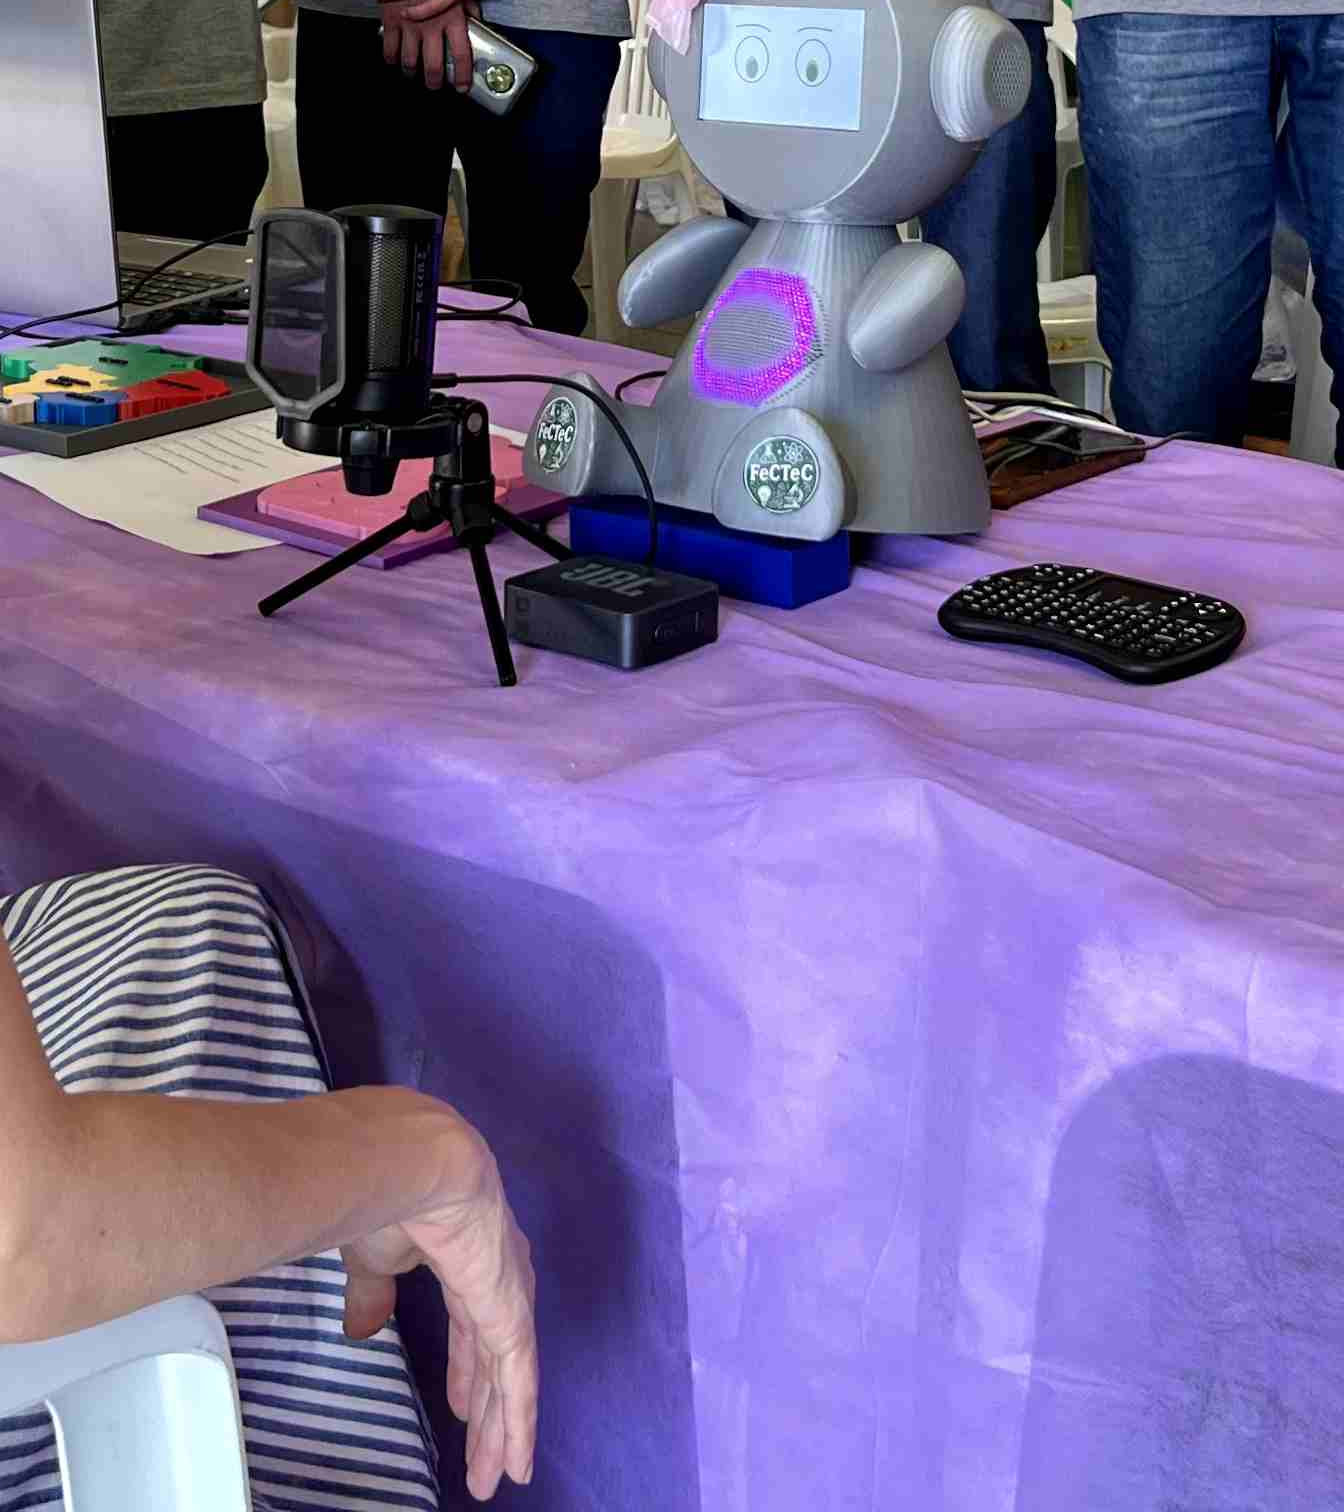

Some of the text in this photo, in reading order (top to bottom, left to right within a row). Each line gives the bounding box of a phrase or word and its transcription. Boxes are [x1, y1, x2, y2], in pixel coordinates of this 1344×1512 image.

[537, 421, 574, 443] FeCTeC
[750, 463, 814, 482] FeCTeC
[559, 562, 656, 598] JBL
